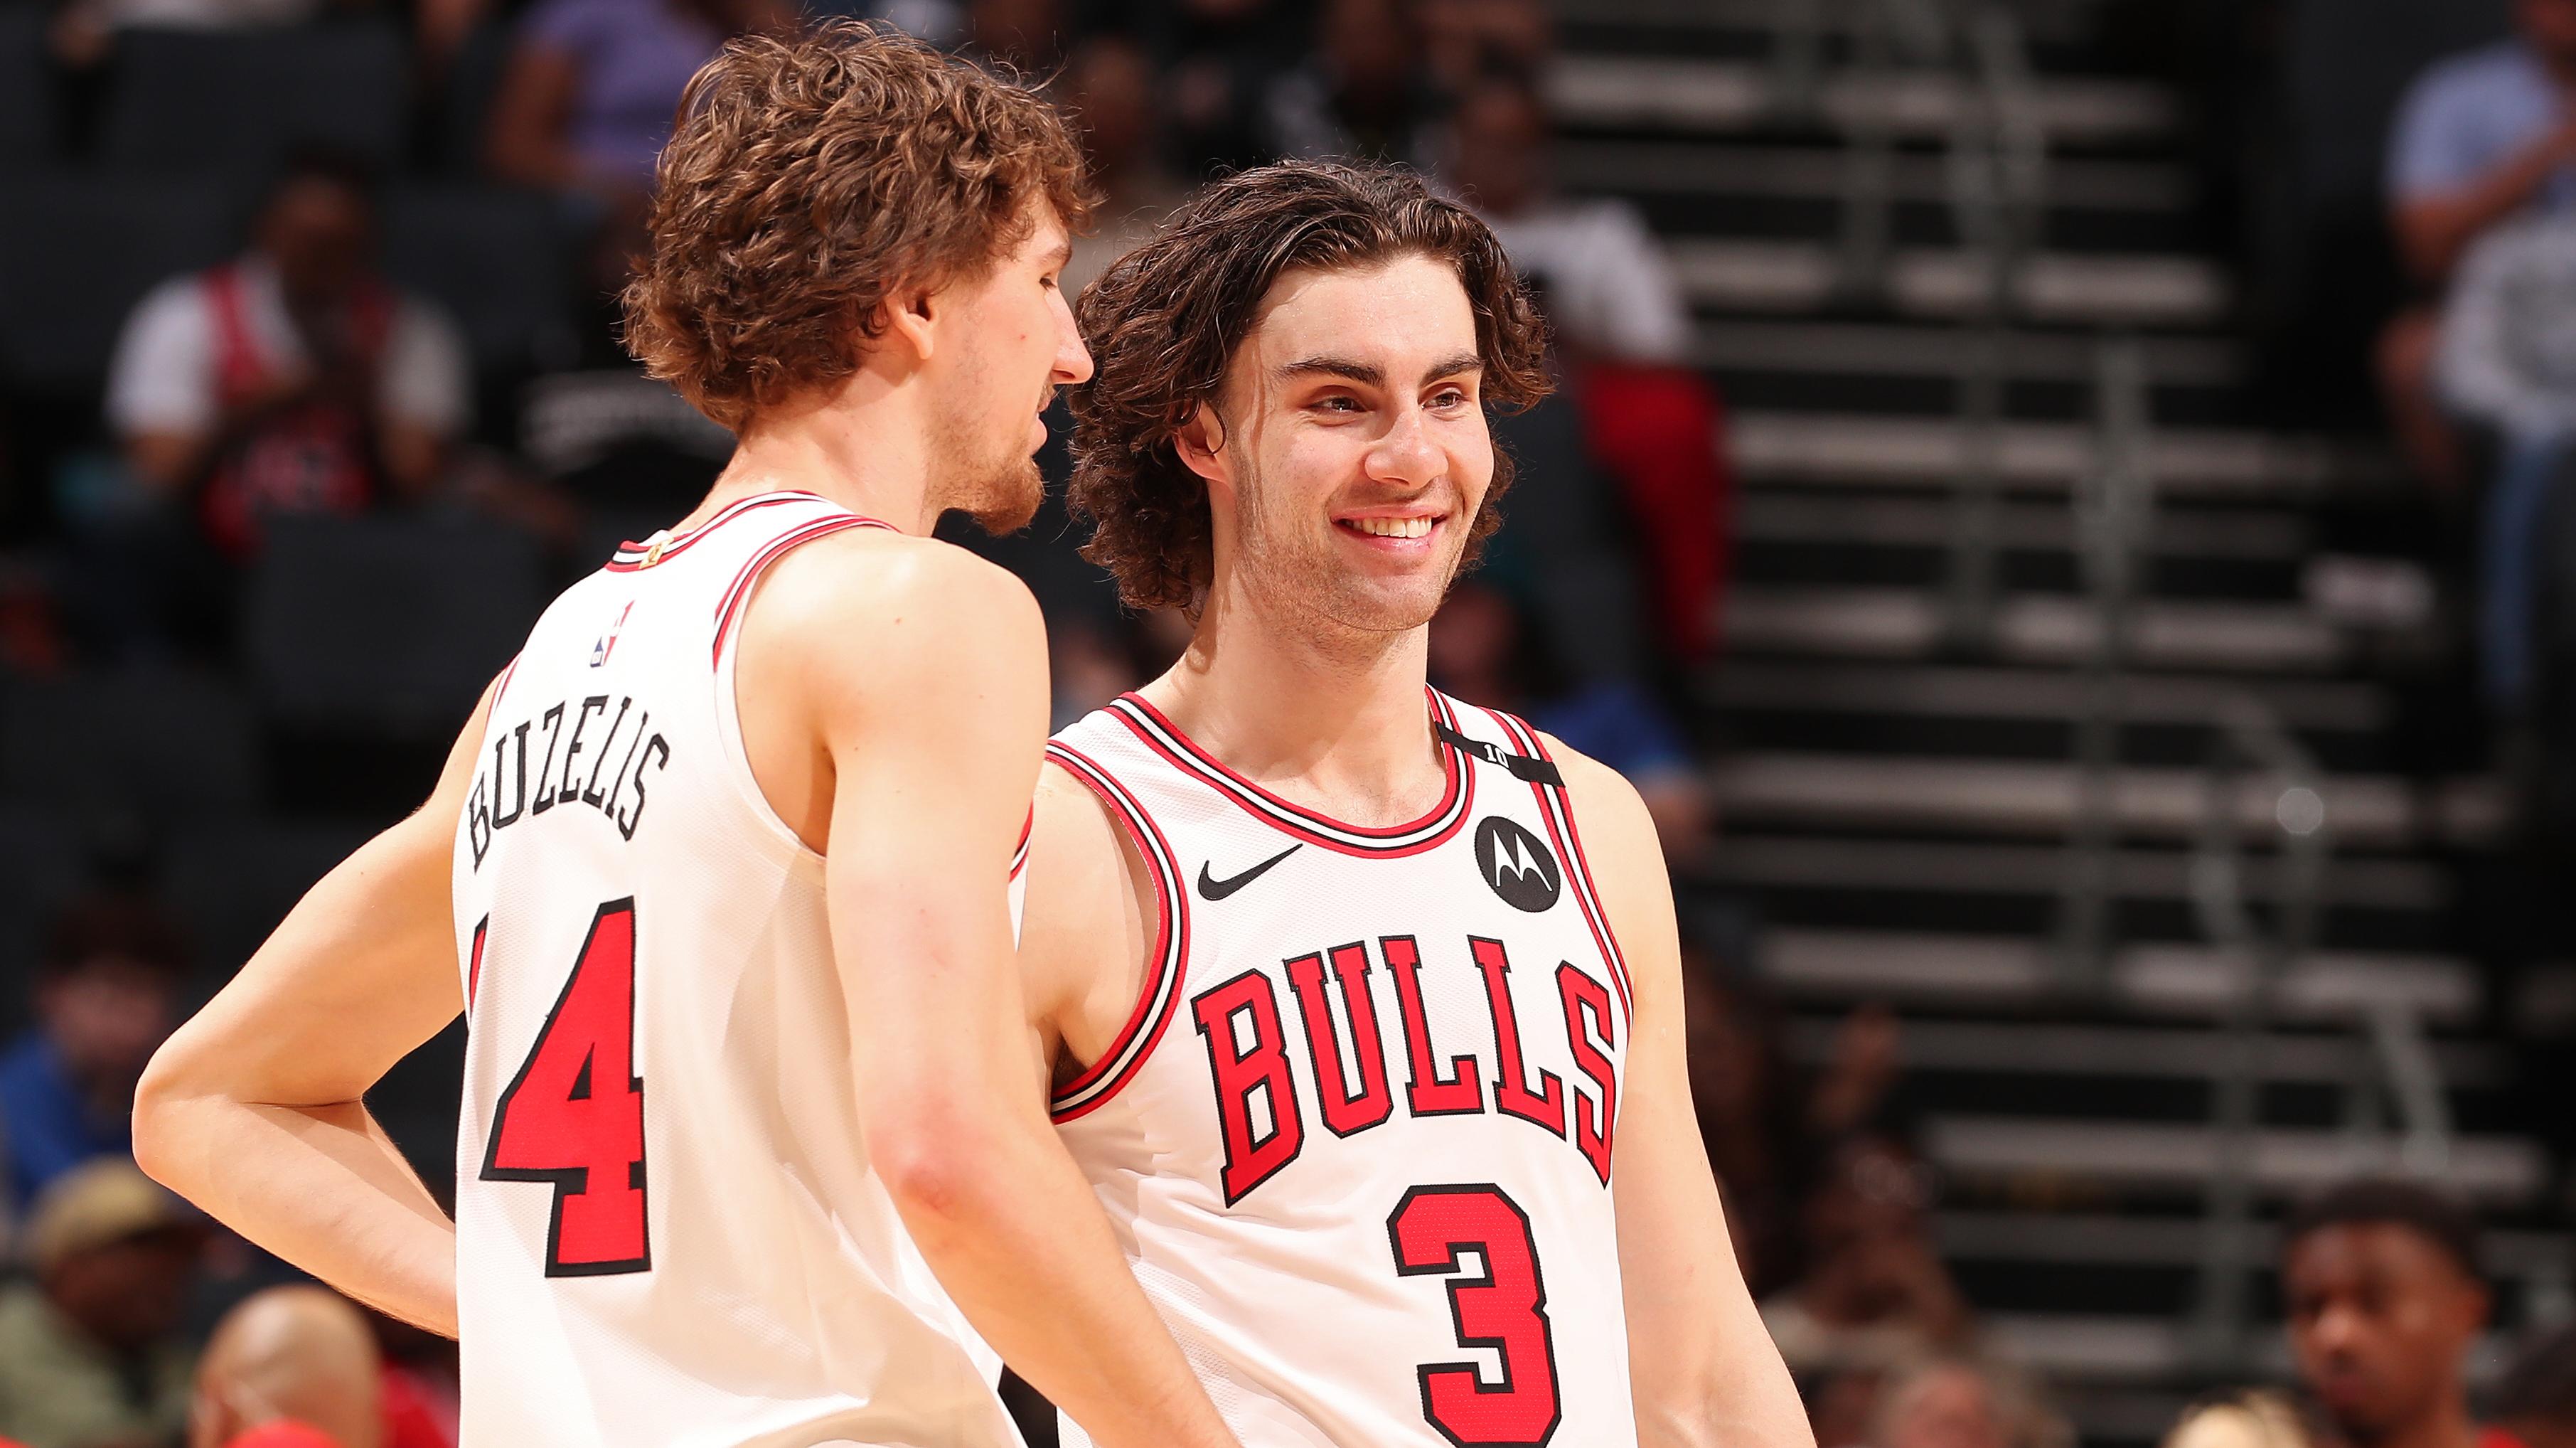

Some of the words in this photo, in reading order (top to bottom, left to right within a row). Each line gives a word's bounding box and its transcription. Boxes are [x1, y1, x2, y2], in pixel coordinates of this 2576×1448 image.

[469, 694, 670, 873] BUZELIS
[1484, 744, 1509, 768] 10
[1190, 935, 1616, 1208] BULLS
[1386, 1183, 1562, 1448] 3
